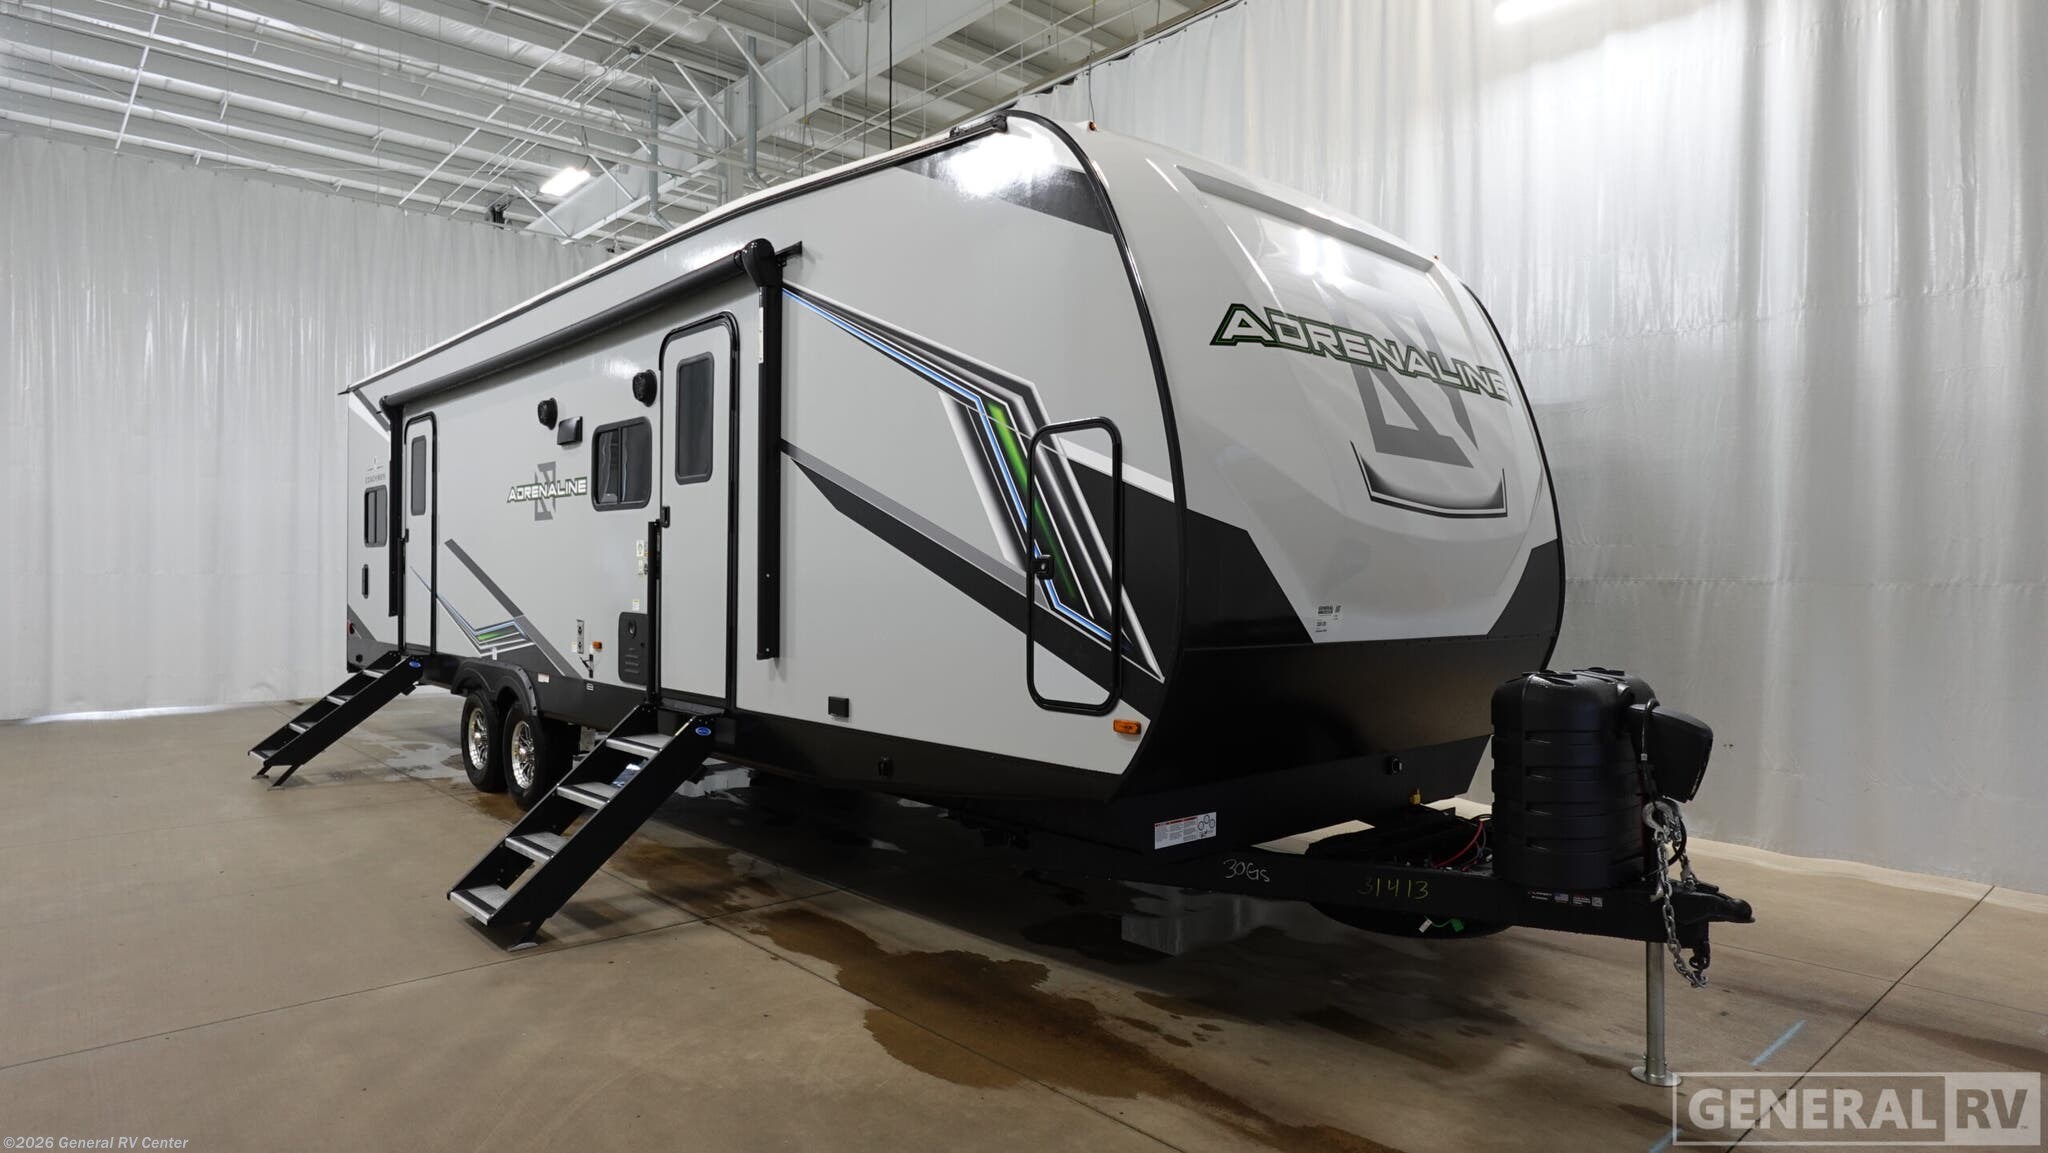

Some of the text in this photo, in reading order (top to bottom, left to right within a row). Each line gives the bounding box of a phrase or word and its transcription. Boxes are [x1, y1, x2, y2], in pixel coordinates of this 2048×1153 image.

[1209, 303, 1512, 407] ADRENALINE
[507, 476, 588, 503] ADRENALINE
[1357, 875, 1430, 900] 31413
